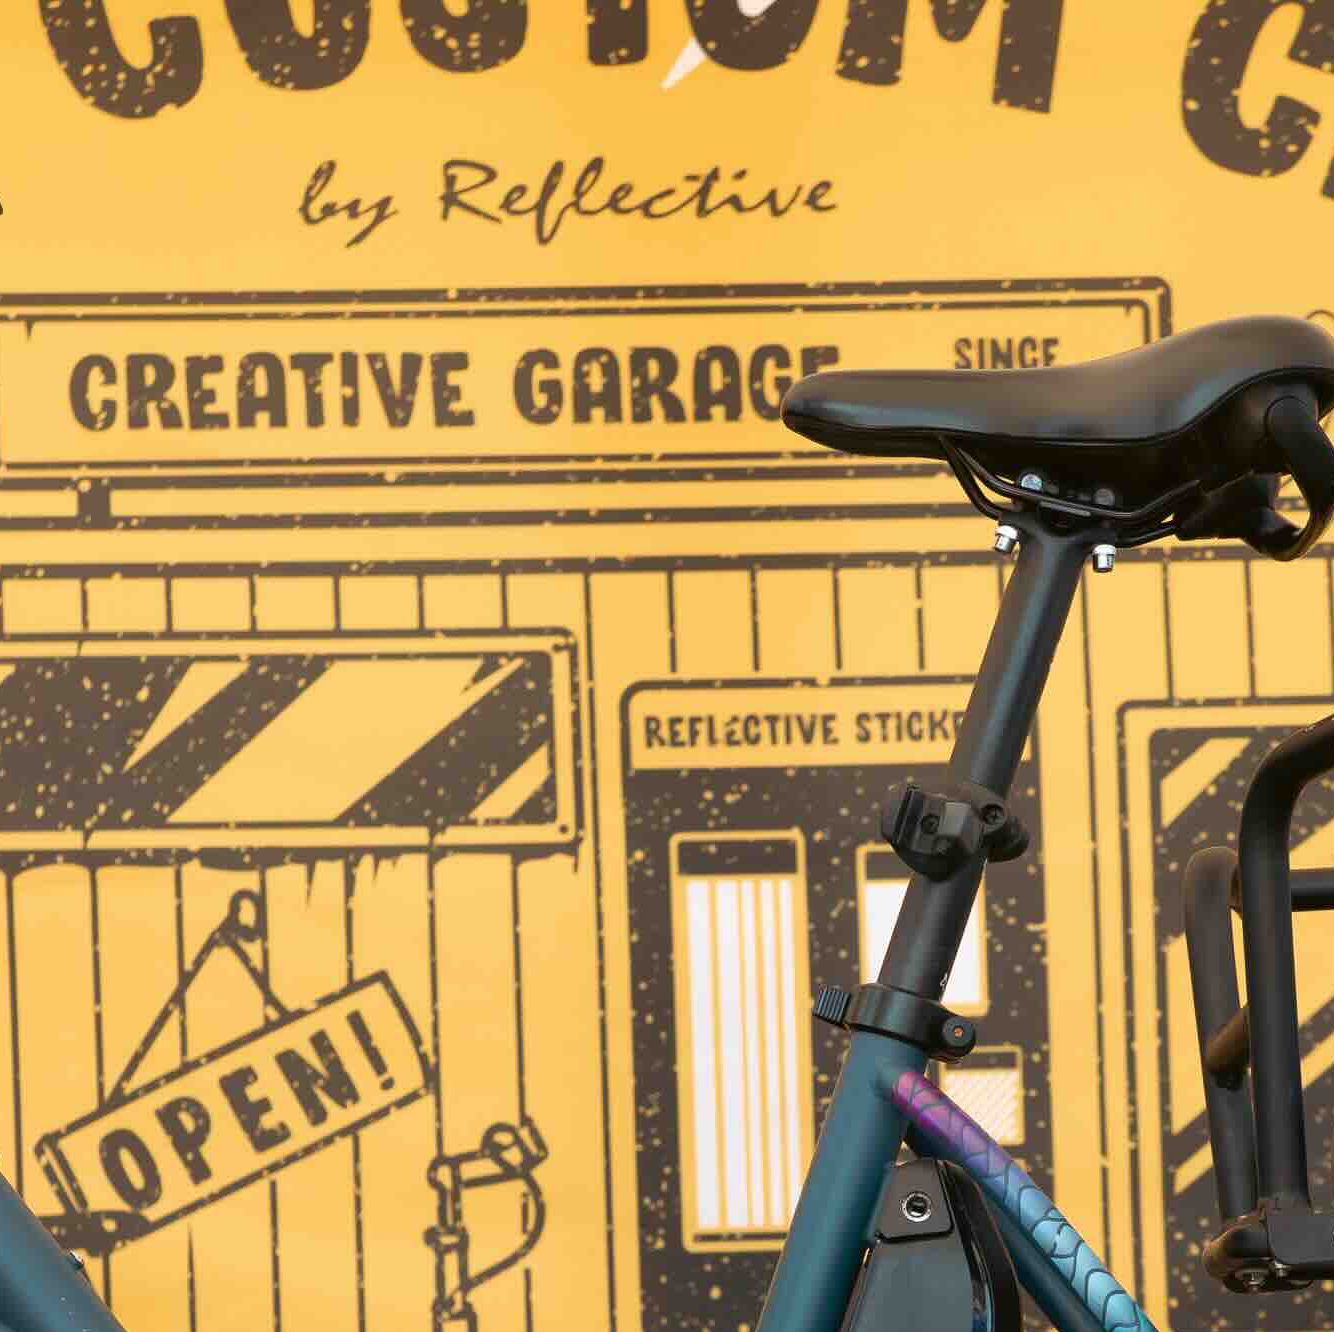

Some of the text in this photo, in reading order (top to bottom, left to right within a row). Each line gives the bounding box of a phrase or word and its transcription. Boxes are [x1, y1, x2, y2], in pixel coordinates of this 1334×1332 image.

[298, 157, 838, 248] by Reflective
[69, 350, 475, 431] CREATIVE
[643, 713, 839, 748] REFLECTIVE
[97, 1008, 397, 1213] OPEN!
